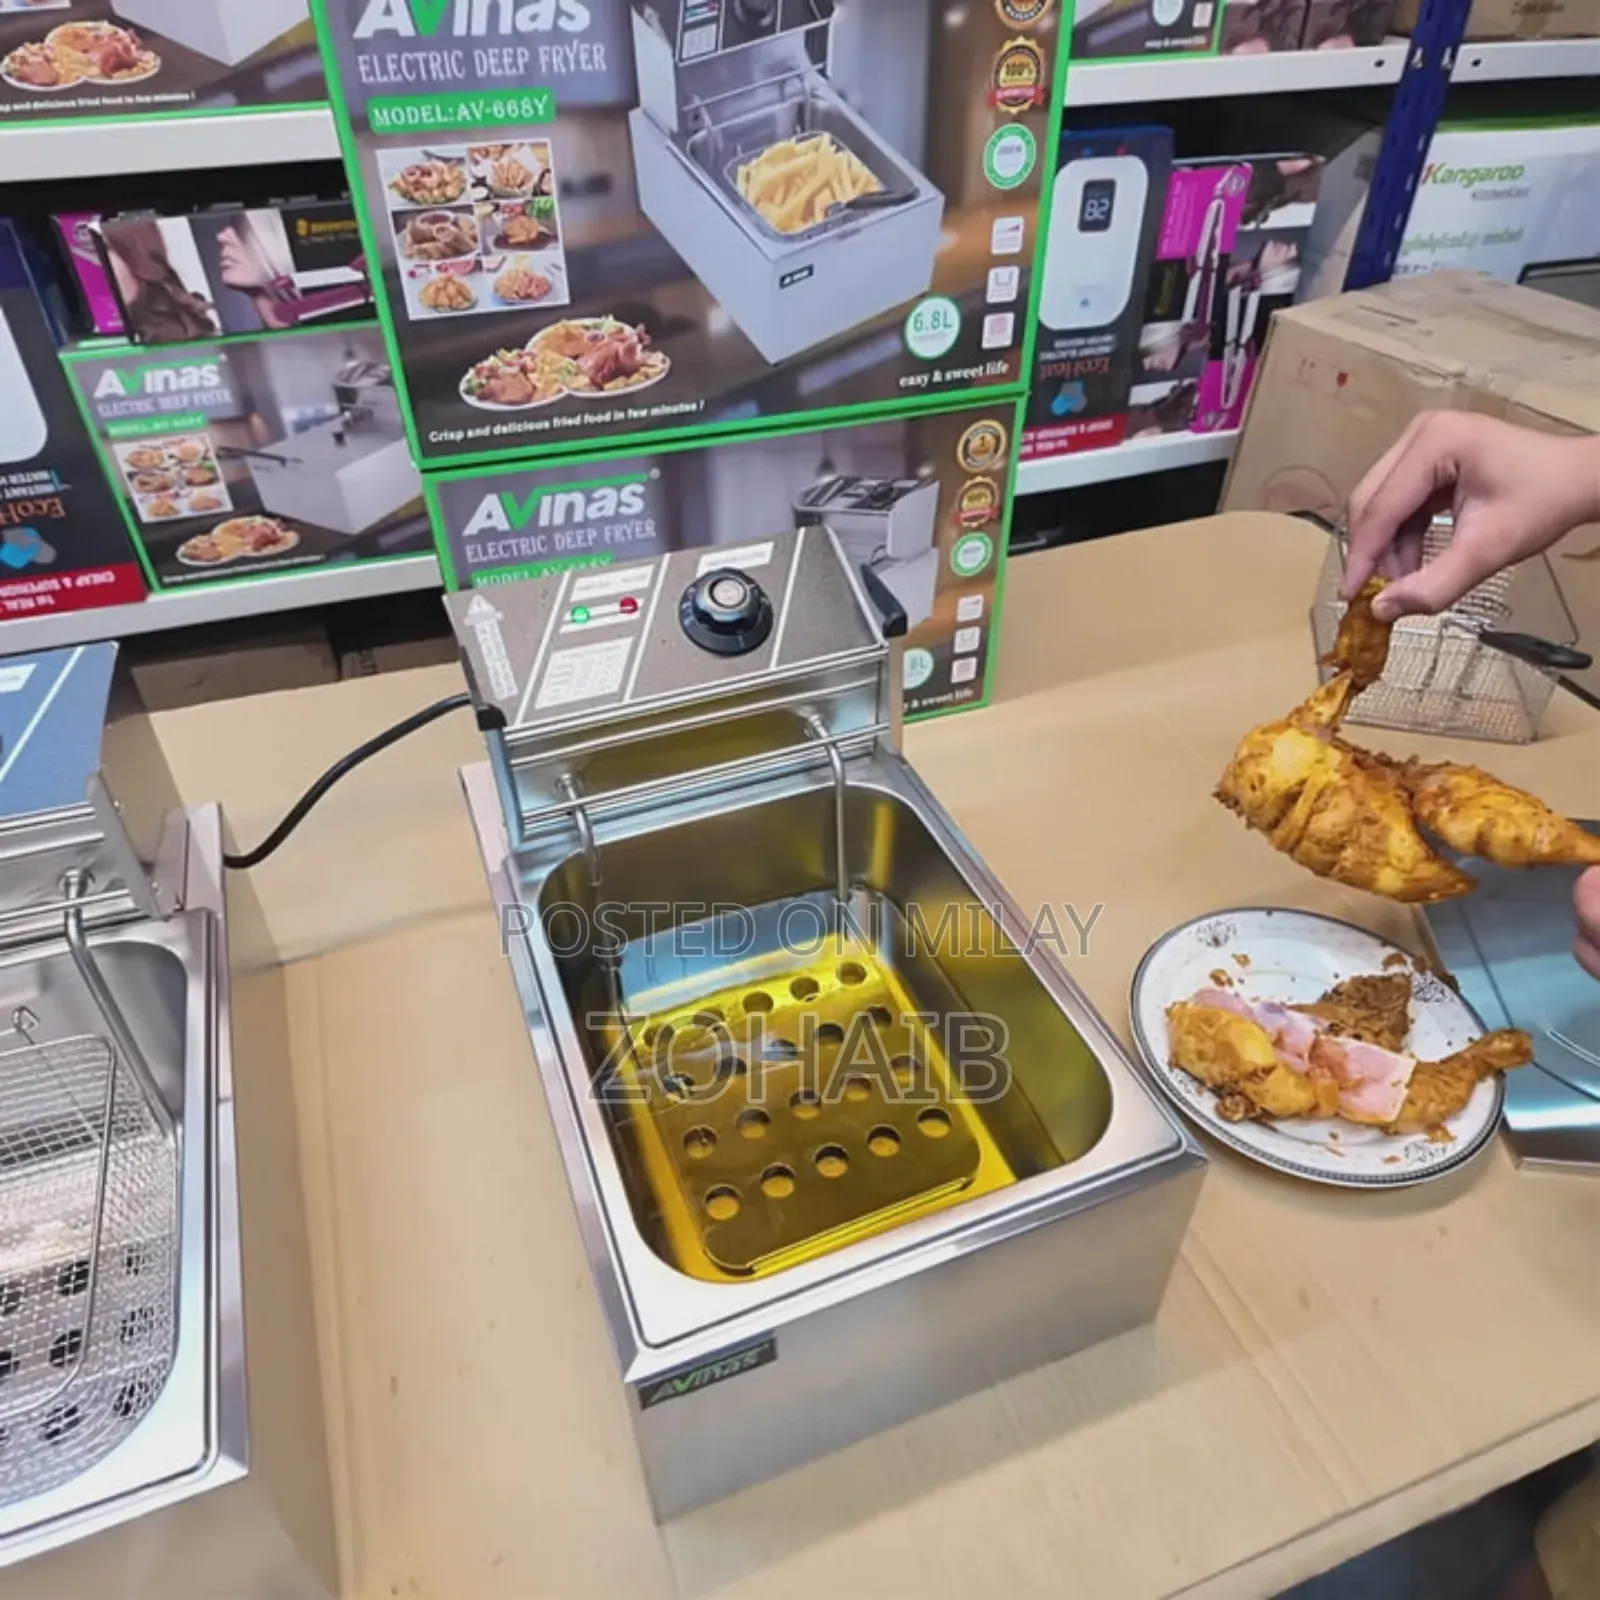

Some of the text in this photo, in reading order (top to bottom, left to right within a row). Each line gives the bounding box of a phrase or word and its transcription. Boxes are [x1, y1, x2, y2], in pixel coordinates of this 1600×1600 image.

[357, 39, 608, 84] ELECTRIC DEEP FRYER
[373, 94, 550, 128] MODEL:AV-668Y
[1422, 162, 1526, 188] Kangaroo
[1084, 197, 1110, 221] 82
[913, 309, 952, 332] 6.8L
[899, 359, 1010, 387] easy & sweet life
[428, 428, 465, 443] Crisp
[466, 424, 491, 439] and
[492, 418, 551, 434] delicious
[553, 414, 581, 428] fried
[583, 411, 612, 425] food
[612, 409, 626, 422] in
[627, 406, 648, 419] few
[650, 402, 697, 418] minutes
[465, 519, 656, 563] ELECTRIC DEEP FRYER
